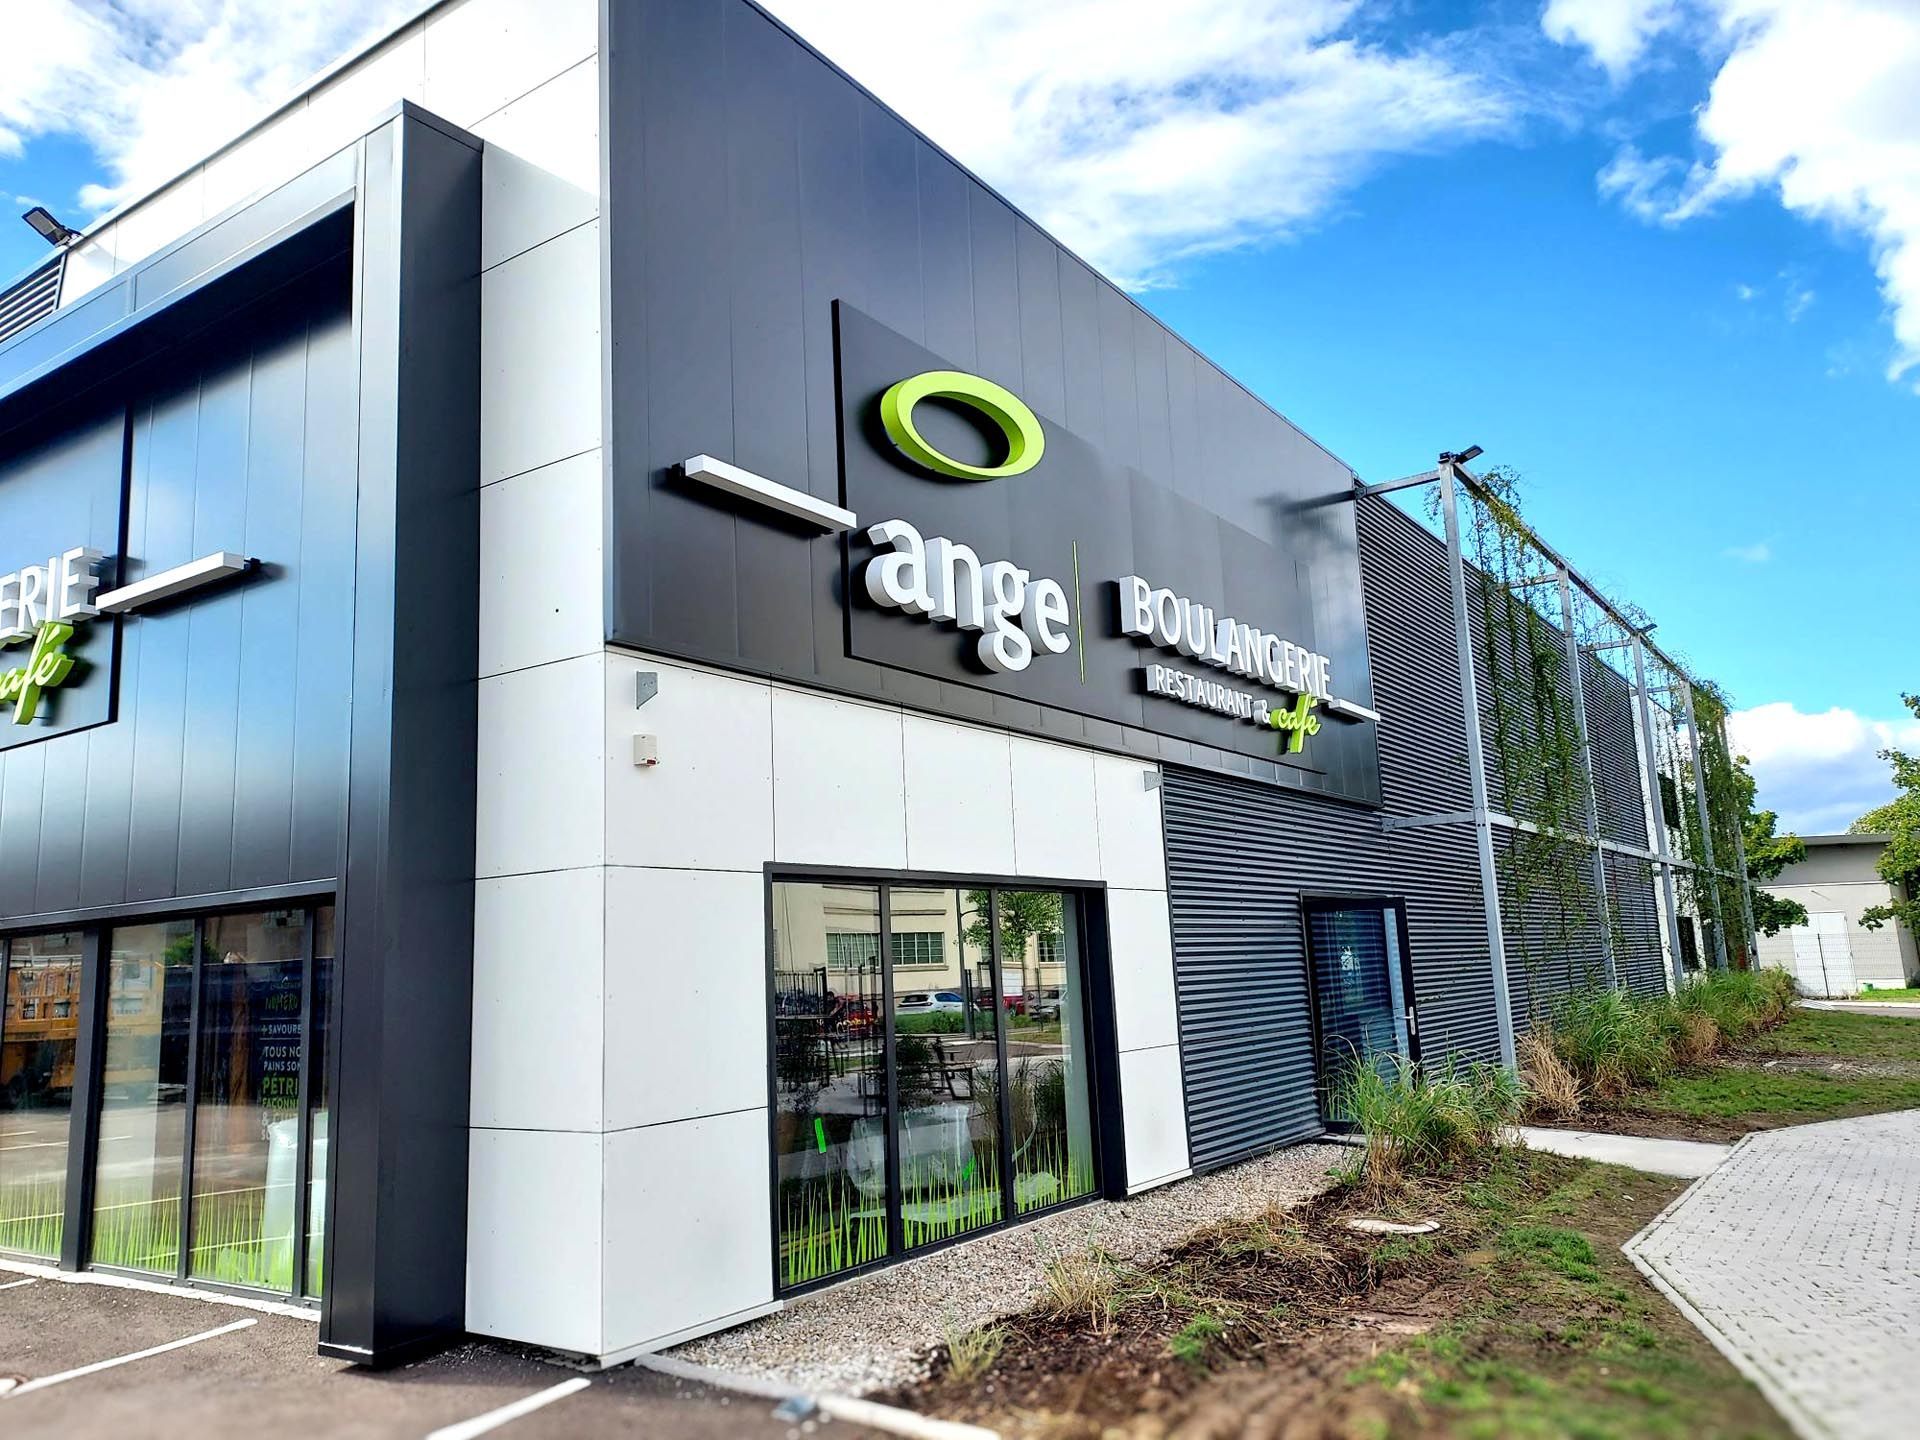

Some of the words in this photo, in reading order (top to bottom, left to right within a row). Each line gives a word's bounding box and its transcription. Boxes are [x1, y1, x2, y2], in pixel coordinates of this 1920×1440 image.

[865, 519, 1071, 672] ange
[0, 621, 74, 725] afé
[1119, 575, 1334, 703] BOULANGERIE
[1146, 664, 1253, 718] RESTAURANT
[1253, 699, 1271, 725] &
[263, 1061, 285, 1071] PAINS
[264, 1046, 287, 1058] TOUS
